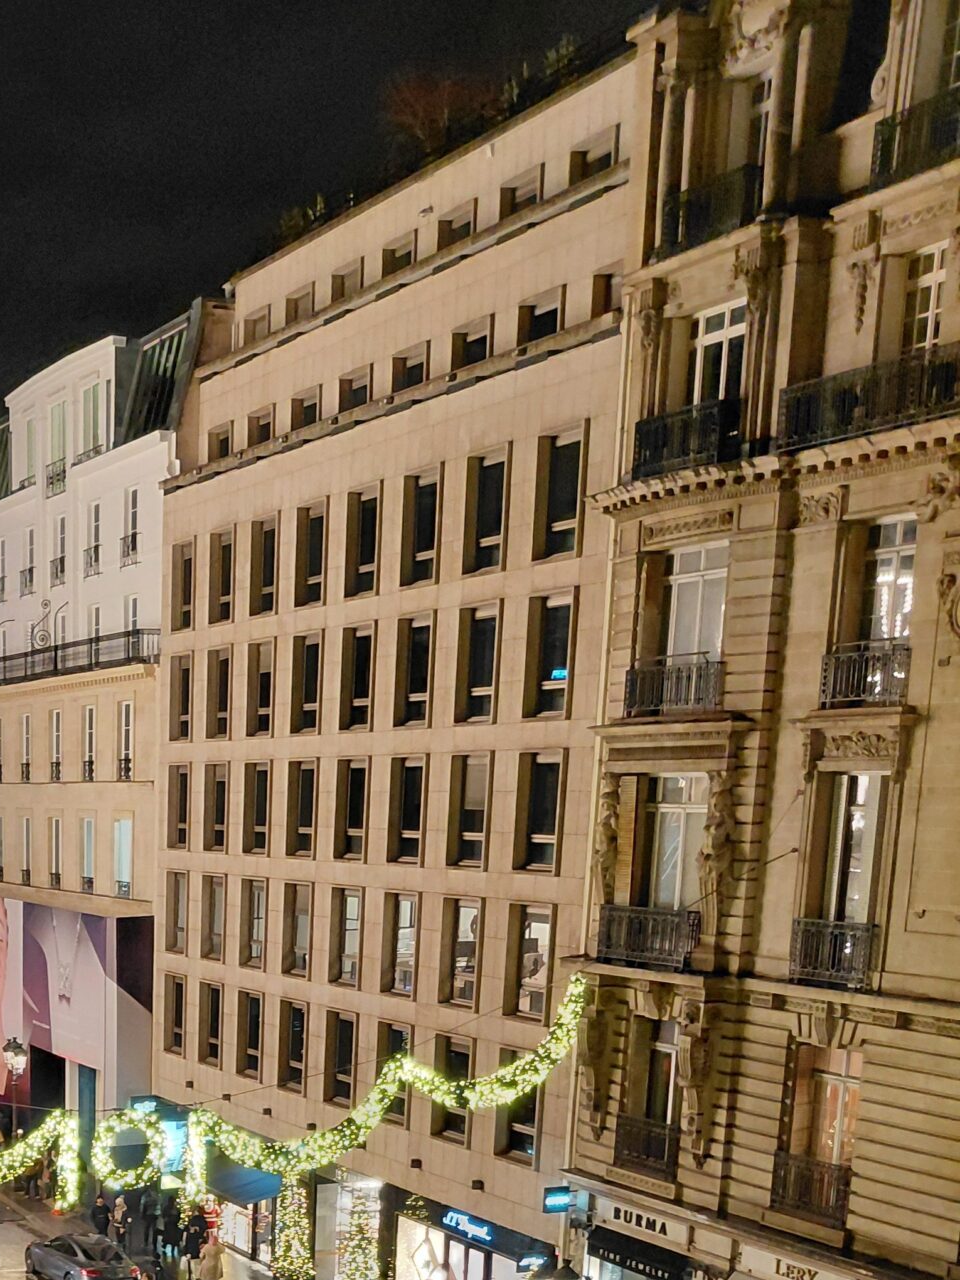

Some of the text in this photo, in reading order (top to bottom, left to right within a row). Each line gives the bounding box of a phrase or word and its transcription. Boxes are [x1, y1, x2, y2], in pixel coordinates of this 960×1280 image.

[614, 1206, 668, 1236] BURMA
[599, 1248, 670, 1280] FINE JEWELRY
